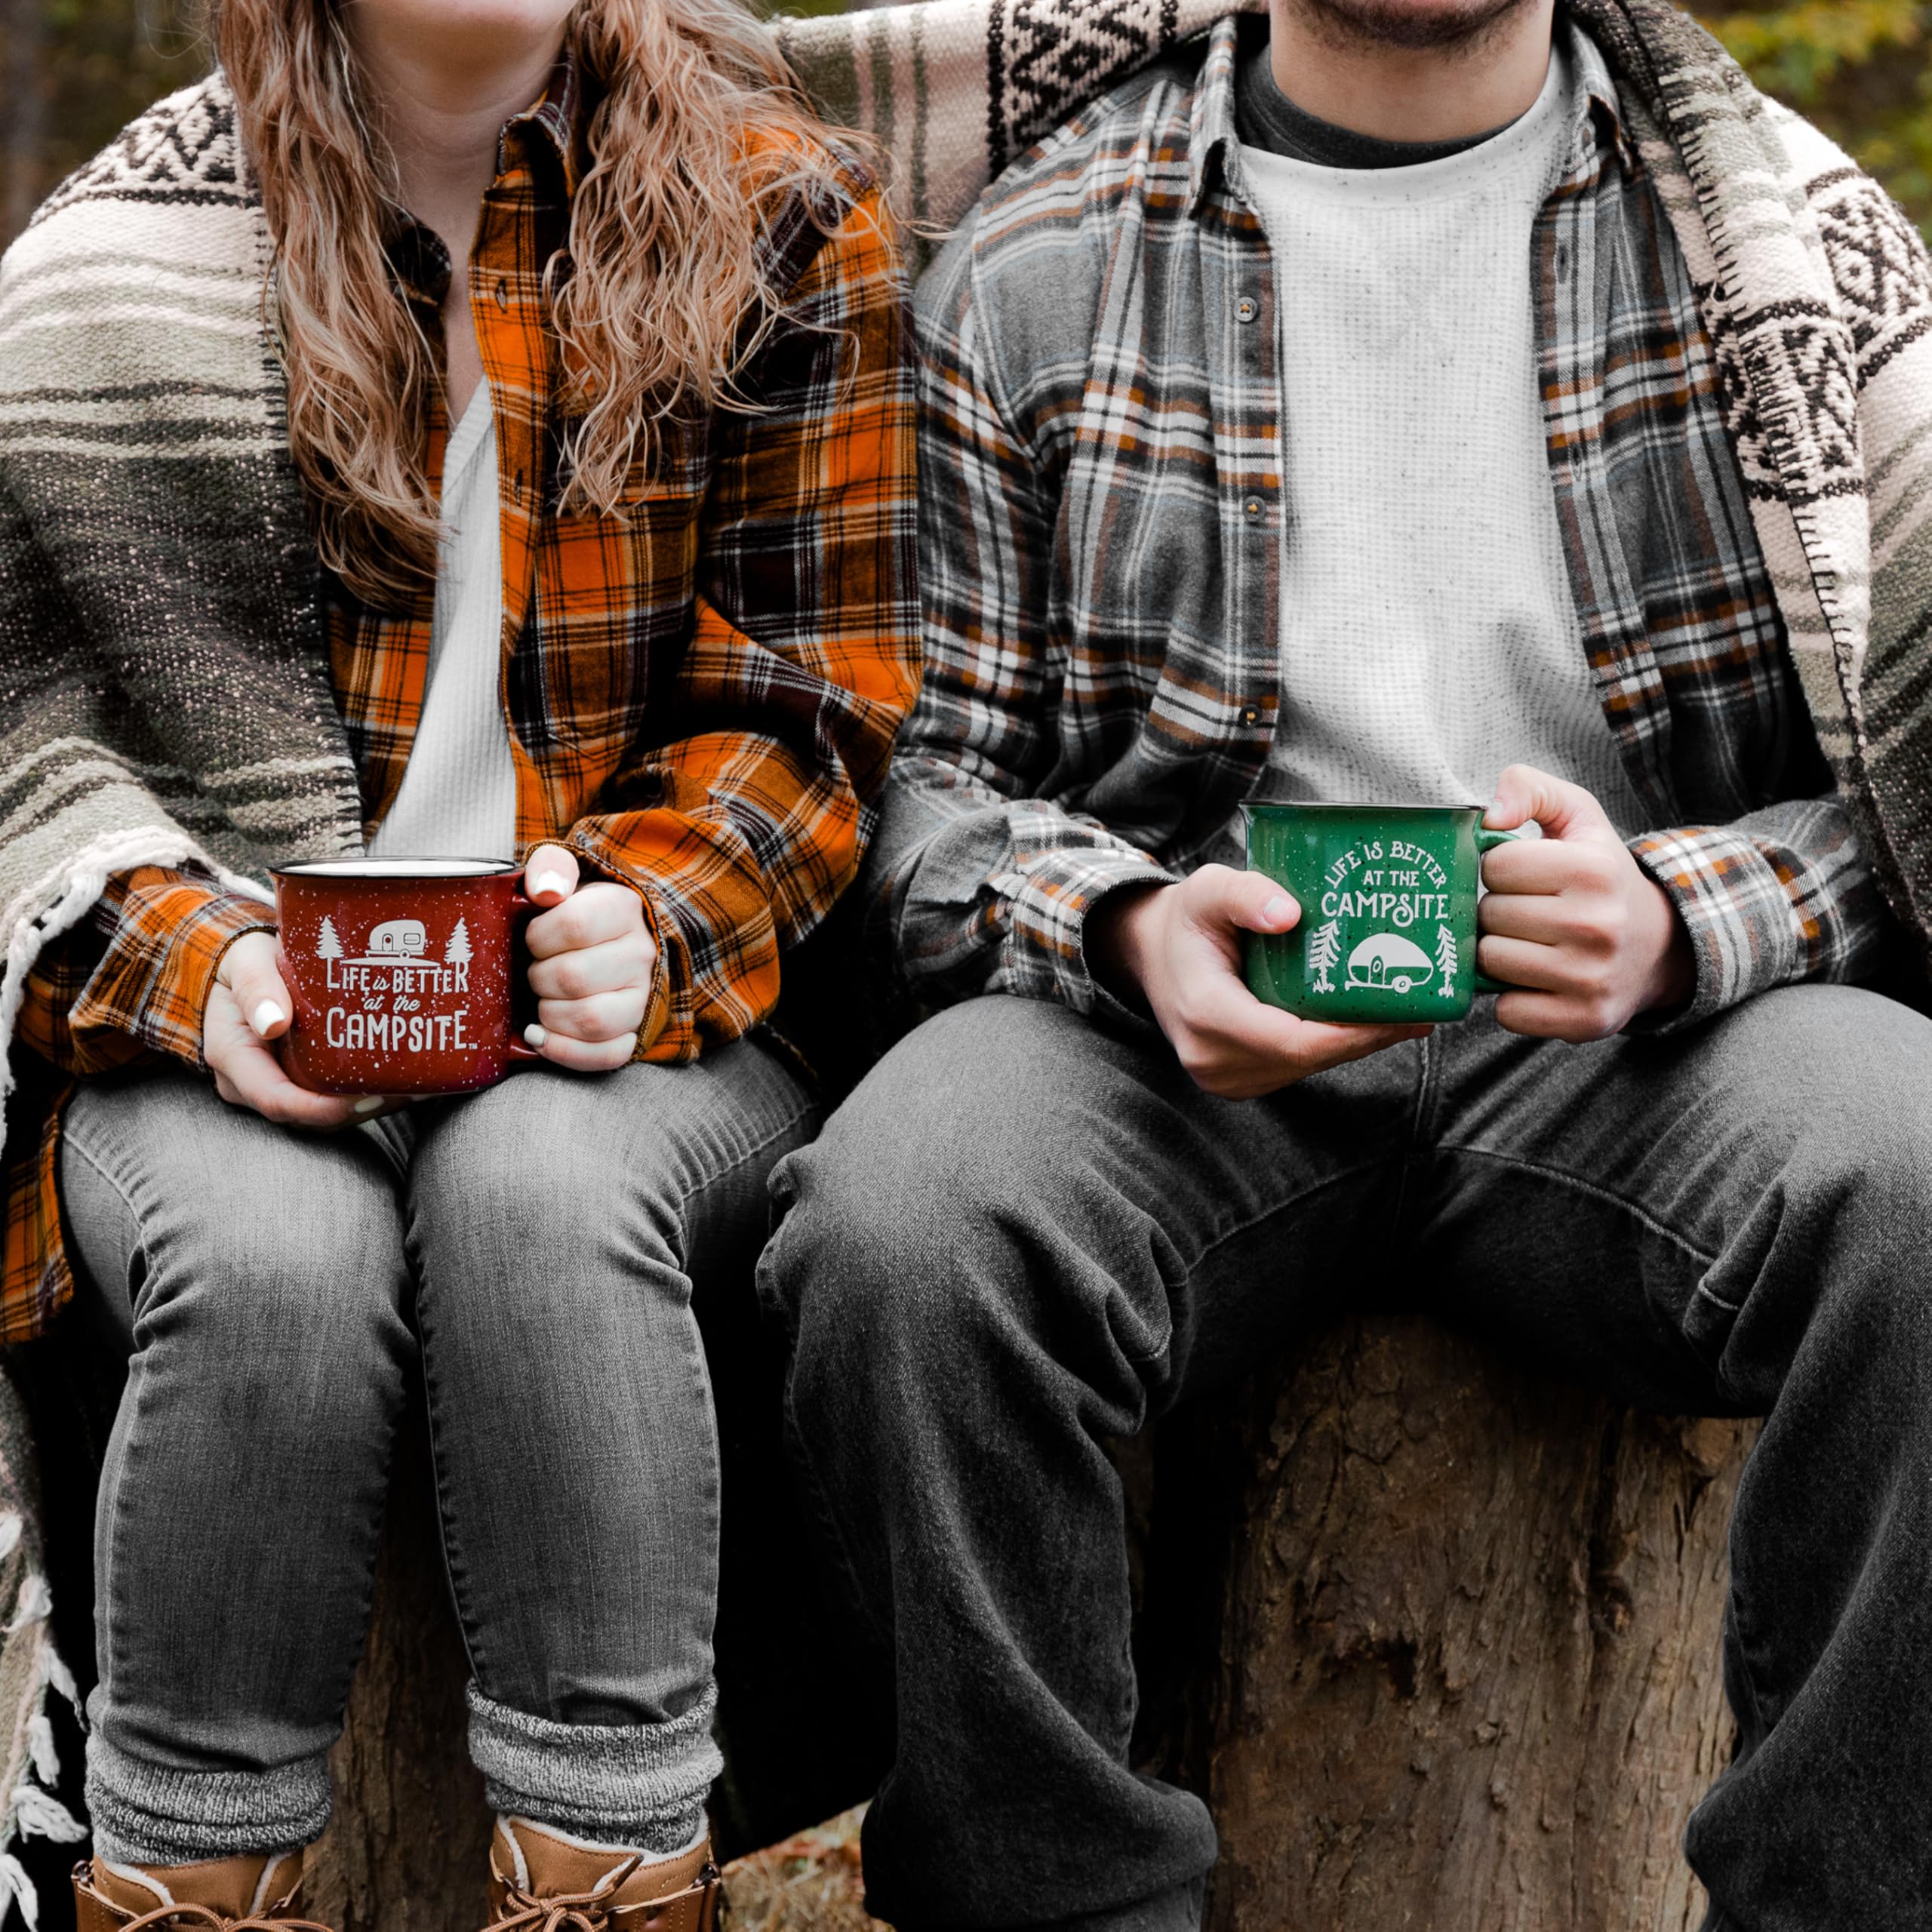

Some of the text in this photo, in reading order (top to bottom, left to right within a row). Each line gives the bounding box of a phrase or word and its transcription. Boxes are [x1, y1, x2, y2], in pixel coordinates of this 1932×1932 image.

[1324, 841, 1447, 889] LIFE IS BETTER
[1363, 870, 1420, 887] AT THE
[1321, 891, 1448, 928] CAMPSITE
[327, 960, 469, 993] LIFE is BETTER
[364, 995, 420, 1011] at the
[327, 1007, 468, 1052] CAMPSITE
